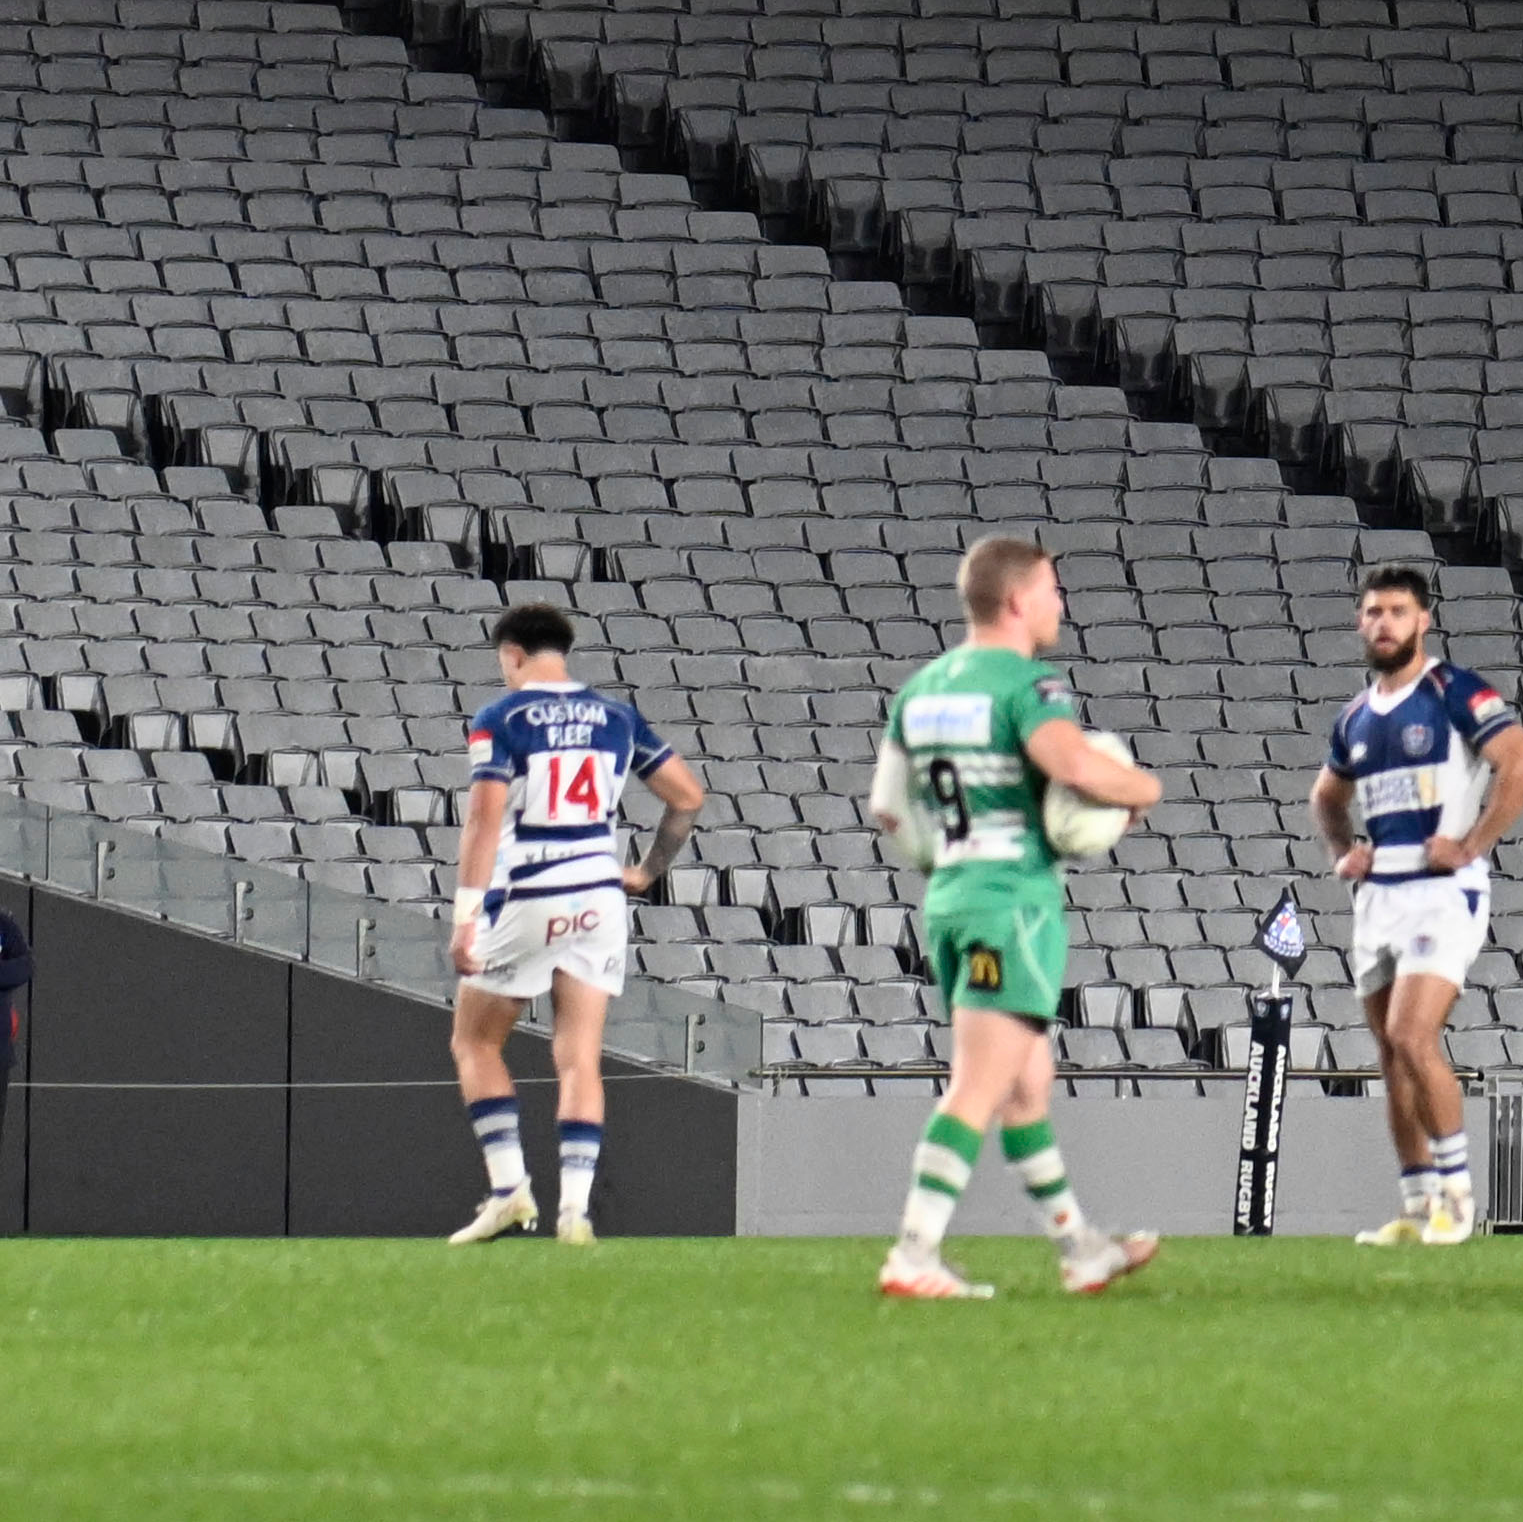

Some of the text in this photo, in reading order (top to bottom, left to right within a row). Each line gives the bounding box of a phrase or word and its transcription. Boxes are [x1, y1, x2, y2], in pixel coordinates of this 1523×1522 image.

[525, 701, 609, 727] CUSTOM
[547, 724, 595, 748] FLEET
[548, 754, 599, 820] 14
[929, 757, 970, 842] 9
[545, 908, 600, 946] pic
[1236, 1042, 1264, 1228] AUCKLAND RUGBY
[1263, 1043, 1287, 1228] AUCKLAND RUGBY
